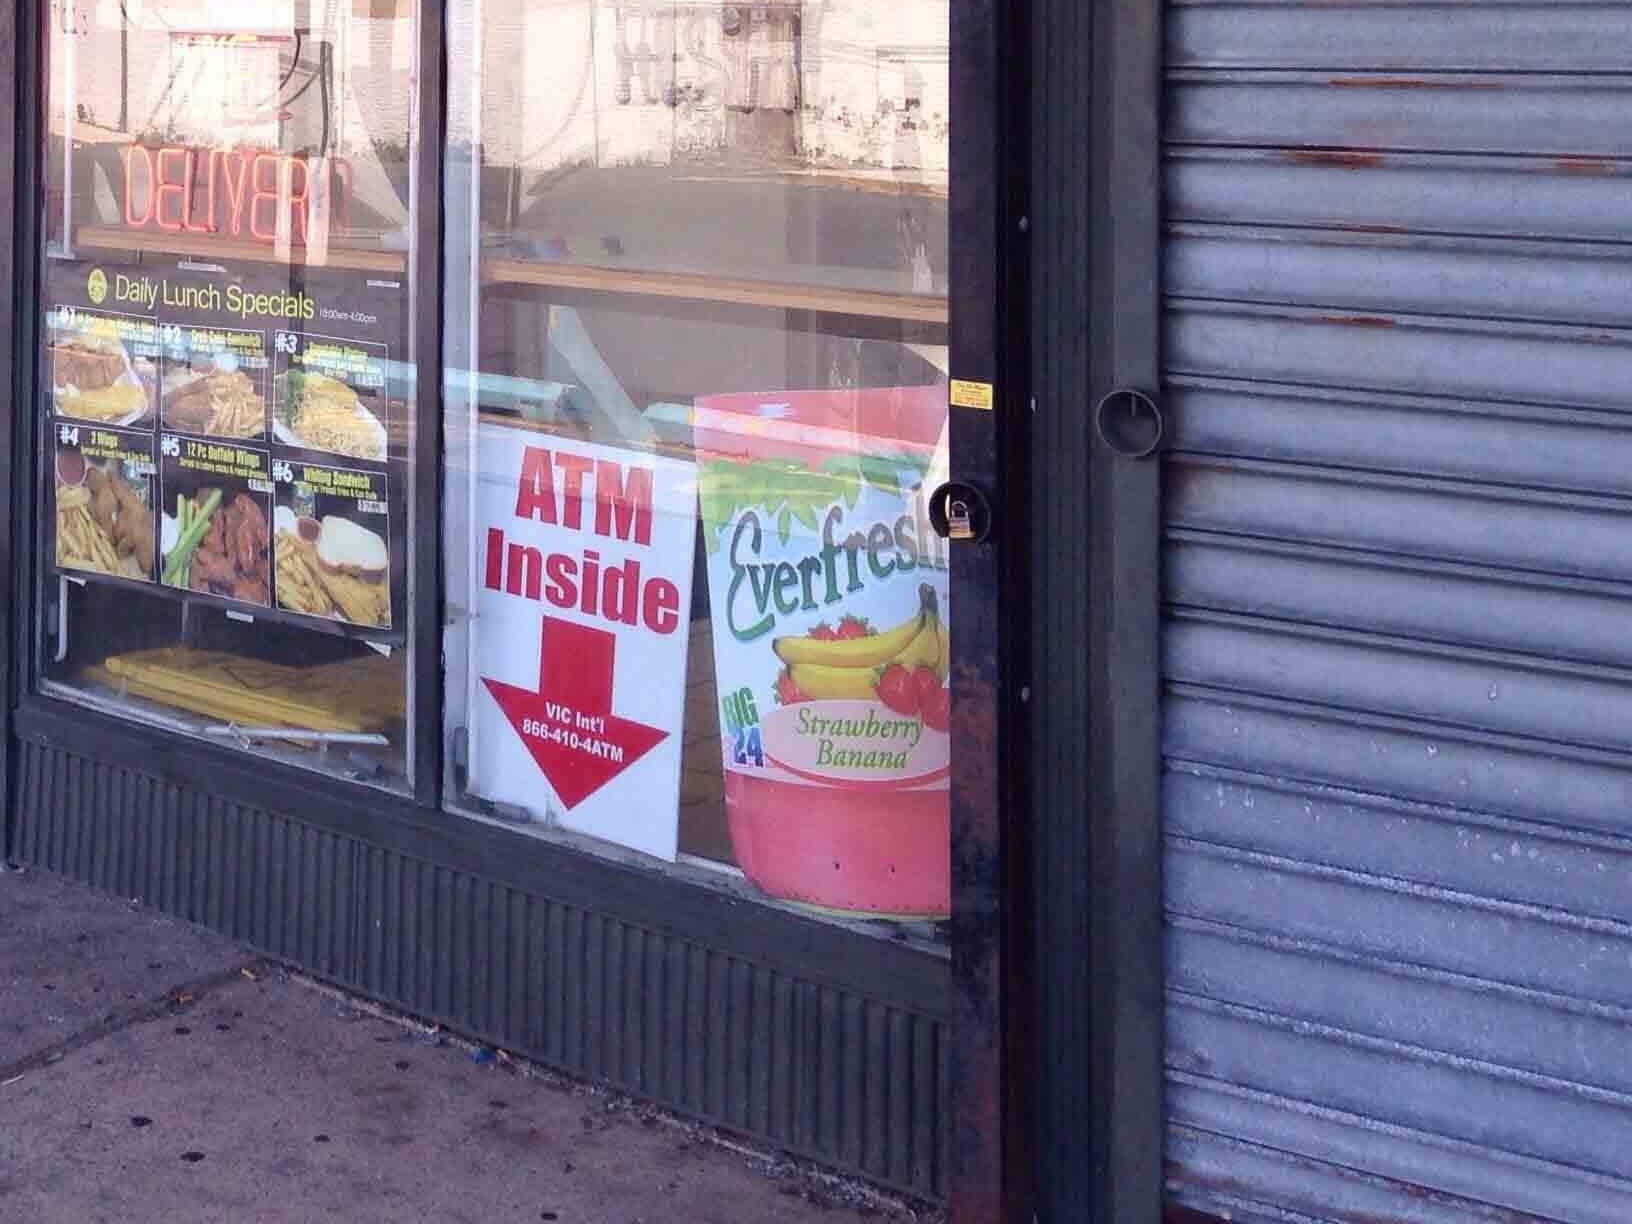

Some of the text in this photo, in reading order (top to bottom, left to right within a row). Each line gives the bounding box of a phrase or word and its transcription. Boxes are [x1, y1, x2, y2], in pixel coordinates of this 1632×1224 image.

[116, 274, 315, 321] Daily Lunch Specials
[275, 333, 298, 354] #3
[60, 426, 79, 446] #4
[161, 433, 180, 457] #5
[272, 459, 294, 483] #6
[515, 445, 654, 545] ATM
[484, 528, 680, 634] Inside
[546, 701, 571, 724] VIC
[721, 687, 759, 726] BIG
[522, 718, 624, 763] 866-410-4ATM
[796, 707, 925, 745] Strawberry
[734, 727, 764, 768] 24
[816, 739, 911, 769] Banana
